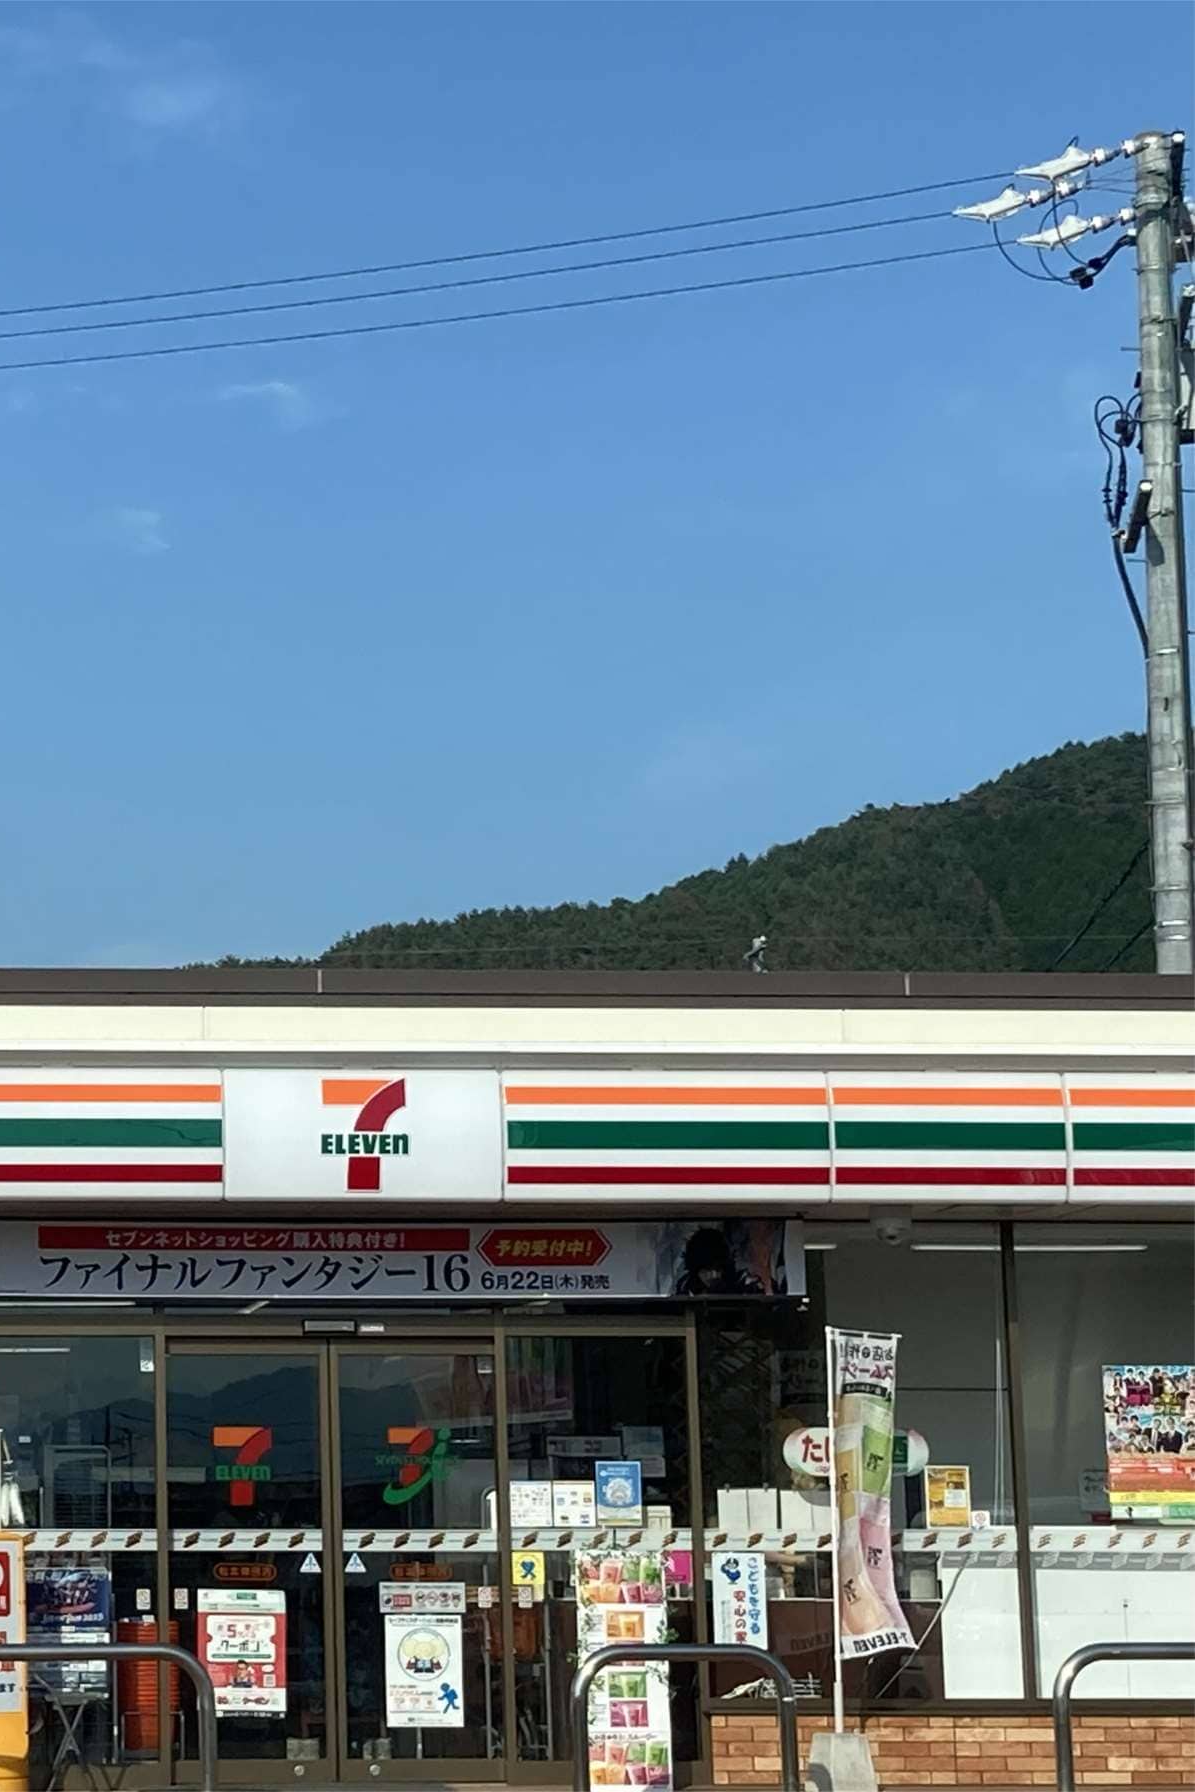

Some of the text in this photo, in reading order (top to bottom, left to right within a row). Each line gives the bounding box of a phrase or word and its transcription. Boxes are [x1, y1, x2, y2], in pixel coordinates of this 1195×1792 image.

[495, 1239, 592, 1257] 予約受付中!
[40, 1252, 471, 1292] ファイナルファンタジー16
